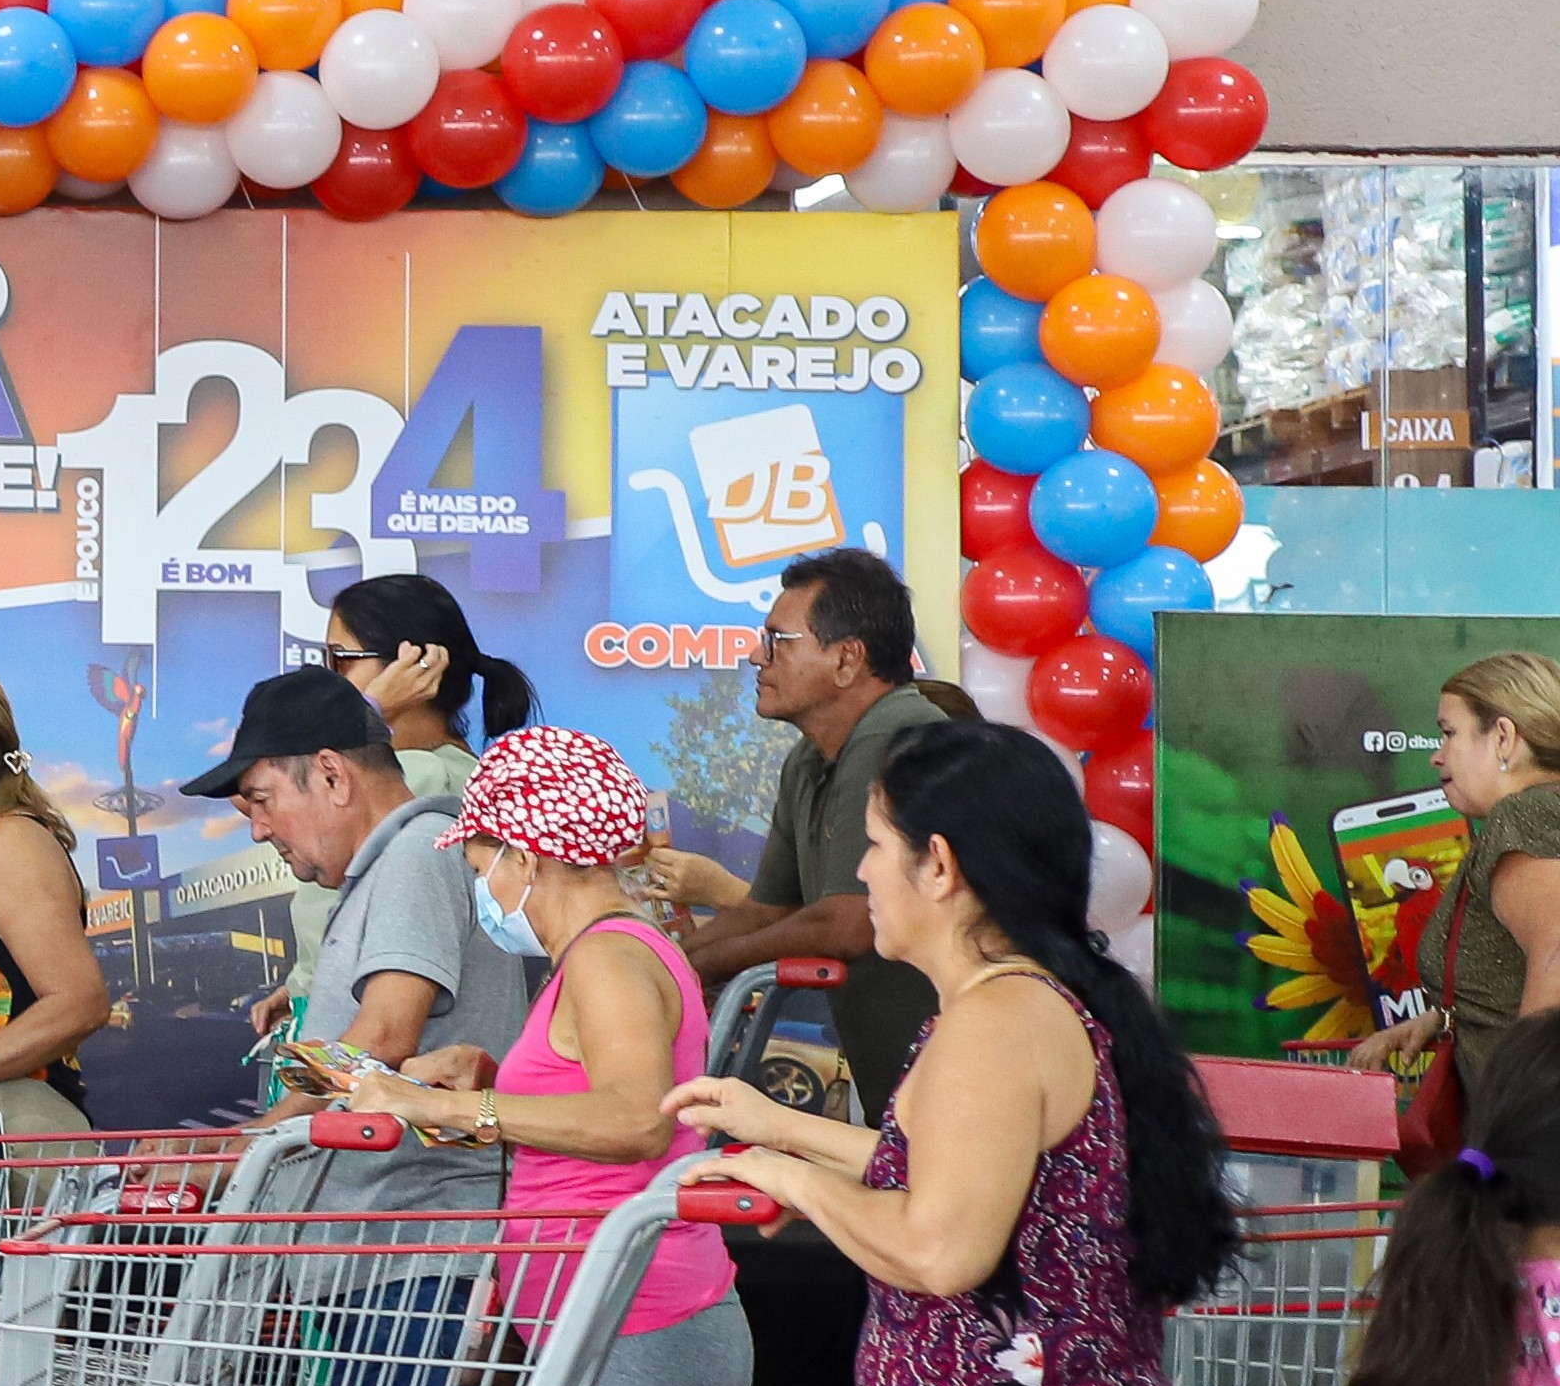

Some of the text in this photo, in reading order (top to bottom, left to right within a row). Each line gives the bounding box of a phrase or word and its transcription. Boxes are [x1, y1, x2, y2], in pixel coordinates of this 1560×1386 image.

[590, 290, 910, 344] ATACADO
[604, 343, 922, 395] E VAREJO
[1383, 417, 1455, 442] CAIXA
[400, 489, 517, 514] É MAIS DO
[707, 452, 831, 523] DB
[76, 476, 100, 578] POUCO
[387, 514, 531, 534] QUE DEMAIS
[161, 557, 252, 584] É BOM
[583, 621, 762, 670] COMP
[187, 869, 245, 903] ATACADO
